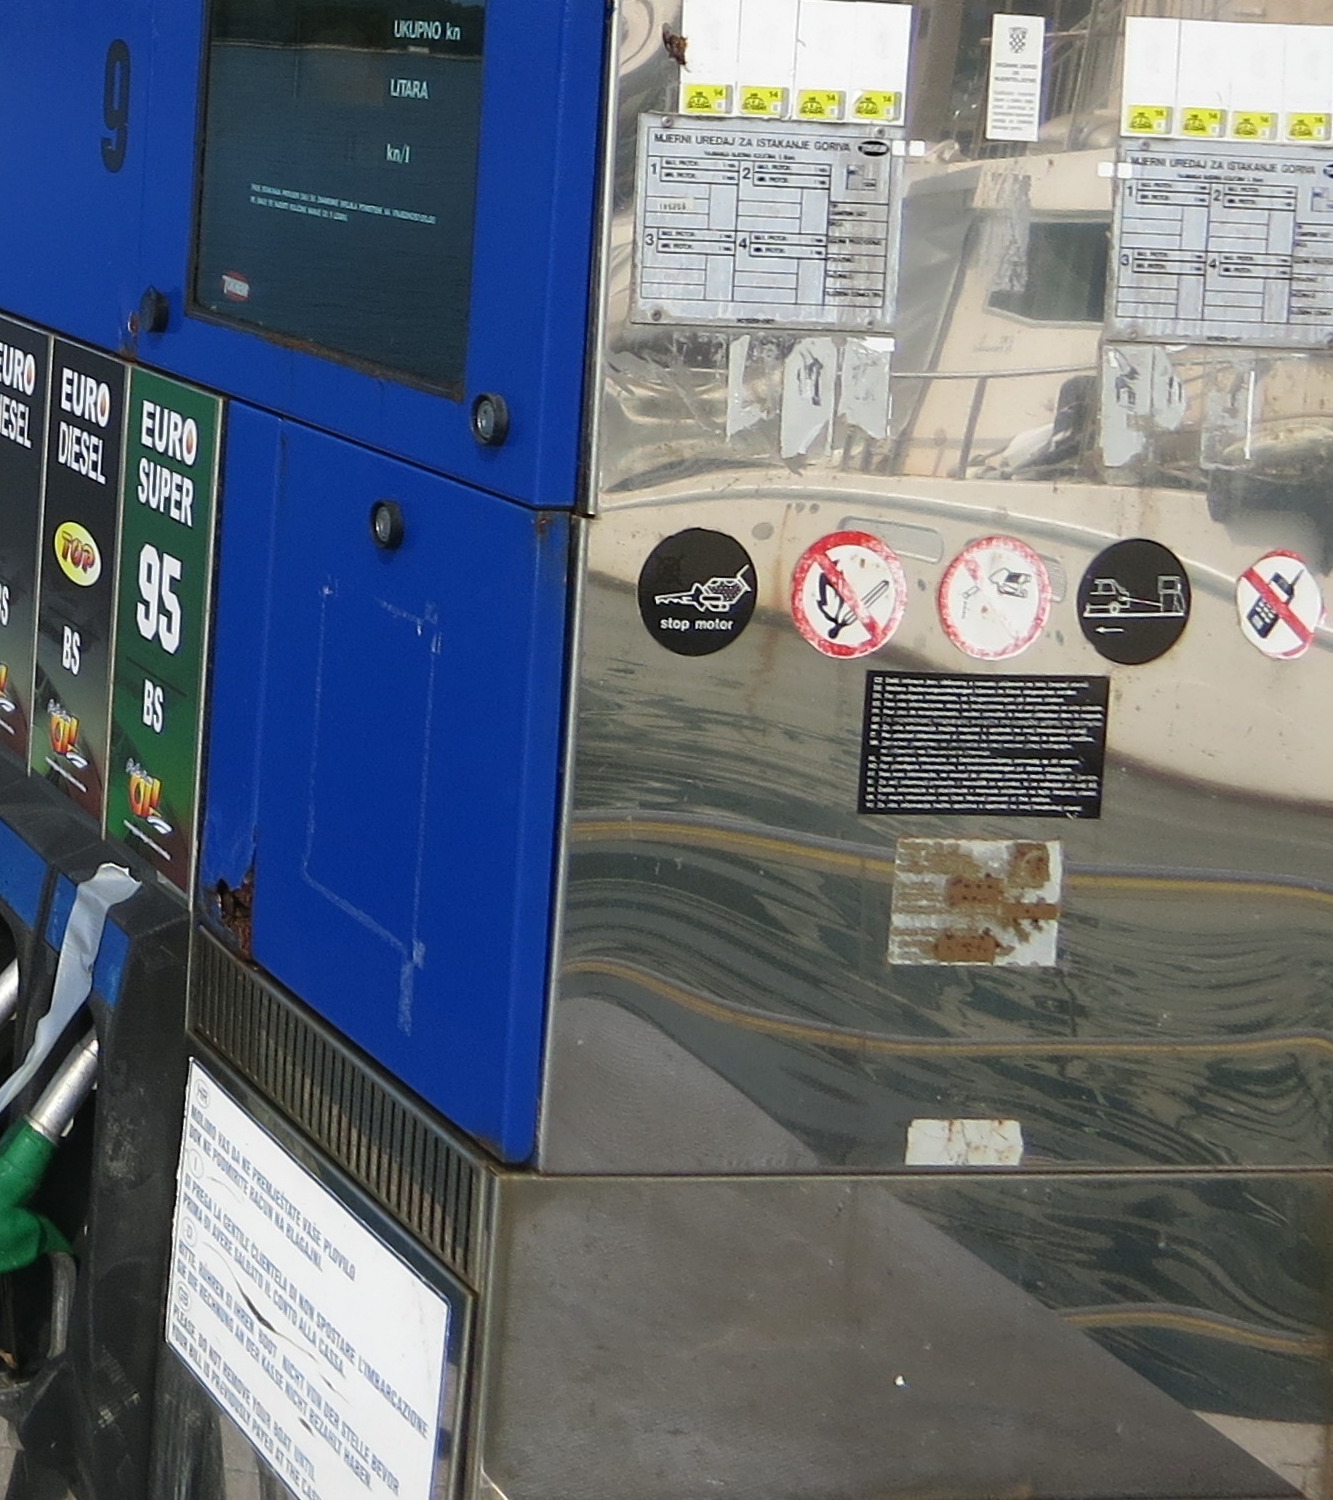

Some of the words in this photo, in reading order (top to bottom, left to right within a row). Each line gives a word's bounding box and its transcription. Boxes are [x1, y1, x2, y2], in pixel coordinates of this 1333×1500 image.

[394, 19, 441, 40] UKUPNO
[445, 22, 461, 41] kn
[390, 79, 429, 99] LITARA
[654, 132, 692, 145] MJERNI
[739, 137, 753, 147] ZA
[756, 138, 810, 150] ISTAKANJE
[814, 141, 851, 152] GORIVA
[650, 162, 657, 175] 1
[742, 168, 751, 180] 2
[1211, 160, 1225, 170] ZA
[1227, 161, 1277, 173] ISTAKANJE
[1212, 189, 1222, 202] 2
[645, 233, 654, 247] 3
[738, 237, 748, 250] 4
[1120, 254, 1130, 267] 3
[1208, 258, 1218, 270] 4
[61, 366, 111, 428] EURO
[58, 420, 107, 485] DIESEL
[141, 398, 199, 468] EURO
[137, 454, 194, 528] SUPER
[59, 532, 96, 575] TOP
[136, 541, 183, 655] 95
[660, 617, 690, 631] stop
[694, 618, 734, 631] motor
[61, 624, 82, 676] BS
[142, 678, 165, 734] BS
[202, 1136, 212, 1159] NE
[274, 1209, 285, 1233] NA
[241, 1154, 251, 1176] NE
[182, 1191, 202, 1224] PRIMA
[212, 1222, 233, 1257] AVERE
[264, 1278, 271, 1298] IL
[273, 1287, 297, 1326] CONTO
[298, 1314, 317, 1347] ALLA
[191, 1179, 212, 1213] PREGA
[213, 1201, 221, 1223] LA
[223, 1212, 249, 1253] GENTILE
[250, 1241, 287, 1293] CLIENTELA
[288, 1280, 297, 1303] DI
[298, 1291, 314, 1322] NON
[315, 1309, 355, 1364] SPOSTARE
[197, 1331, 207, 1355] DO
[208, 1343, 221, 1371] NOT
[222, 1359, 251, 1406] REMOVE
[251, 1394, 270, 1429] YOUR
[273, 1418, 291, 1454] BOAT
[234, 1321, 244, 1346] AN
[245, 1333, 260, 1364] DER
[261, 1351, 284, 1391] KASSE
[285, 1378, 307, 1417] NICHT
[308, 1405, 342, 1456] BEZAHLT
[257, 1326, 277, 1361] BOOT
[281, 1353, 304, 1392] NICHT
[306, 1380, 322, 1411] VON
[323, 1399, 339, 1431] DER
[341, 1418, 369, 1464] STELLE
[370, 1452, 399, 1498] BEVOR
[275, 1444, 284, 1467] AT
[284, 1455, 300, 1486] THE
